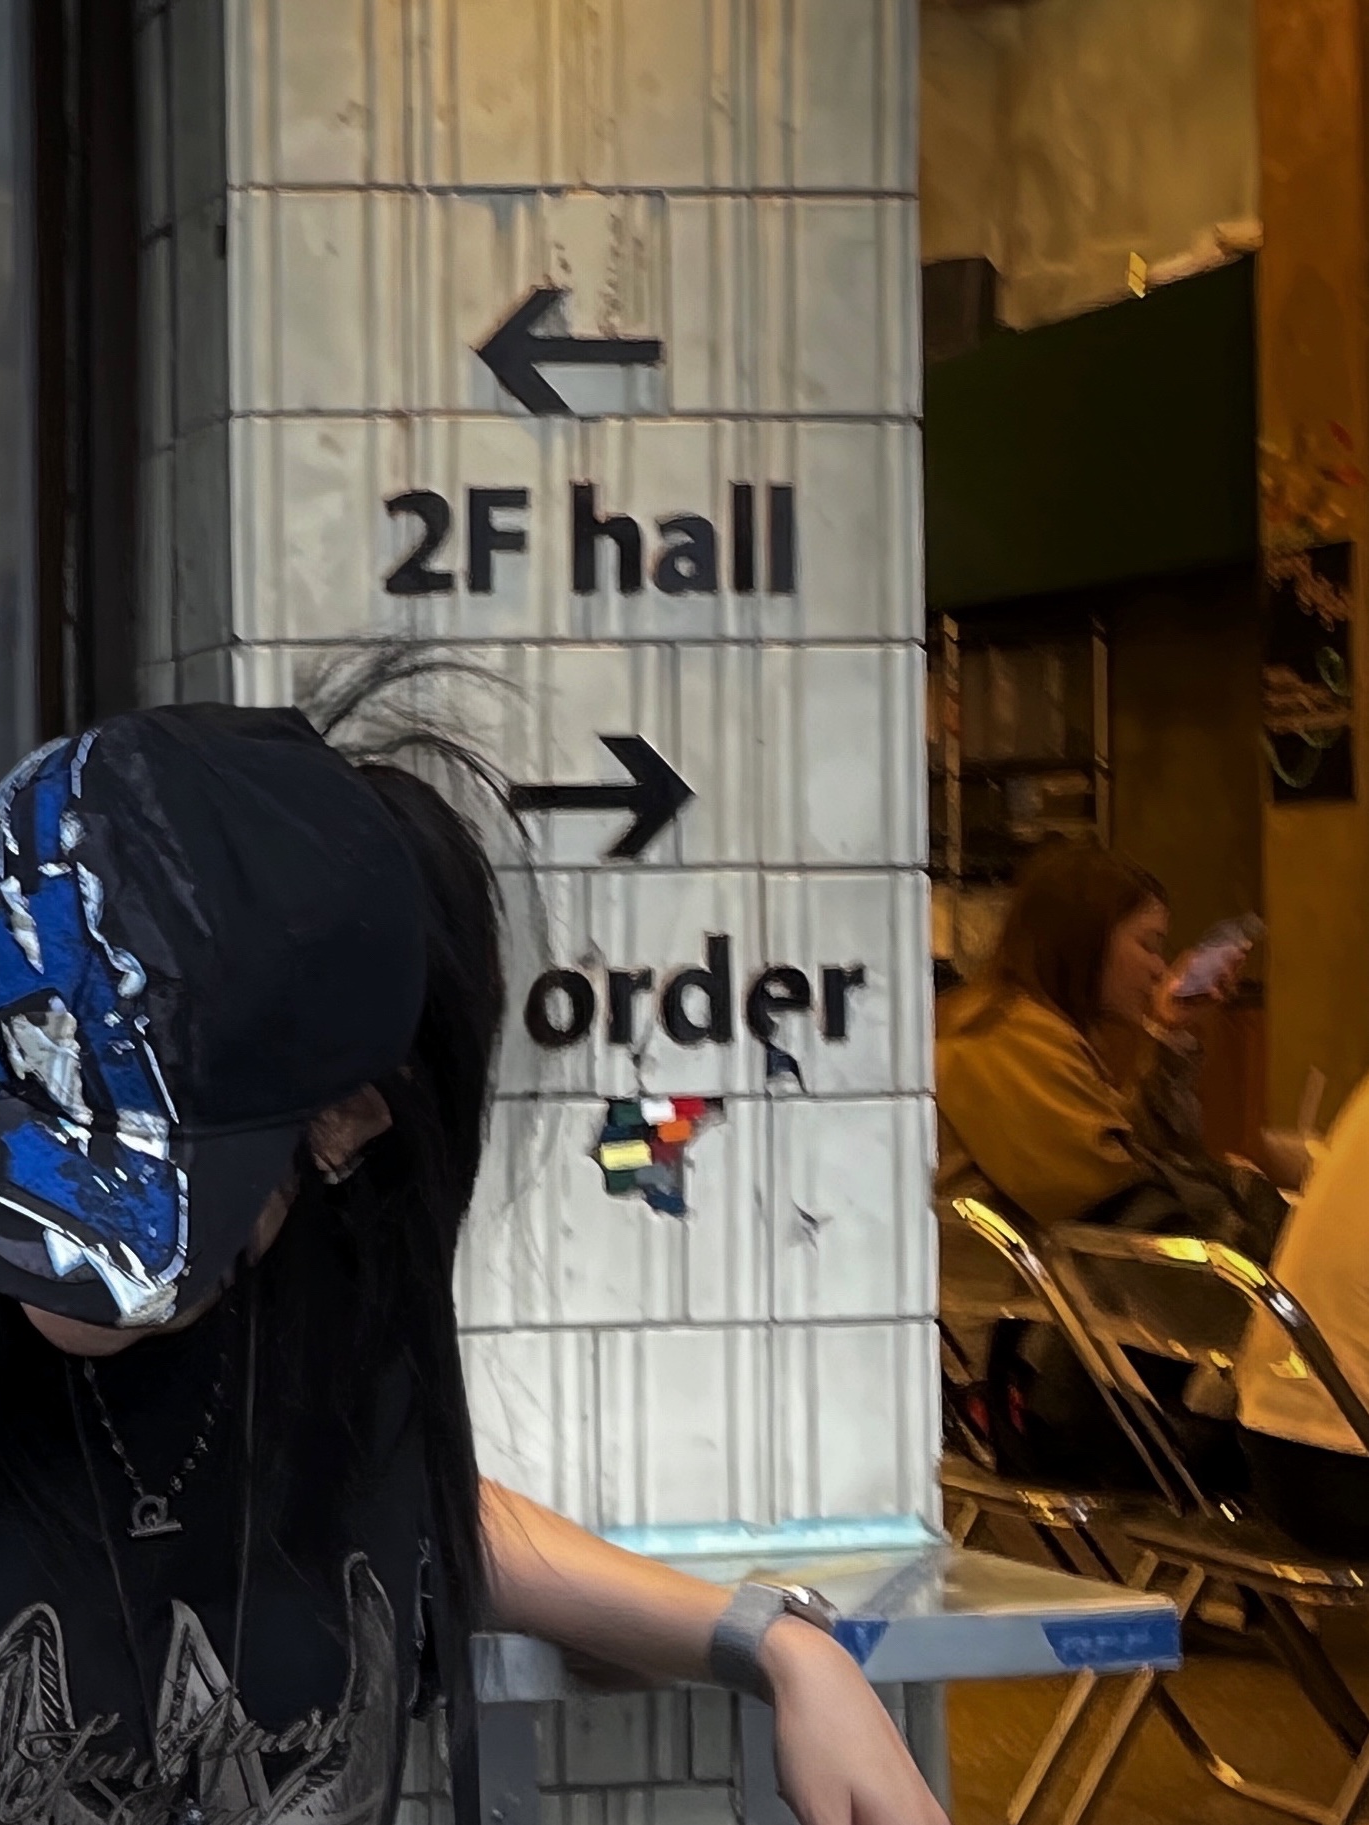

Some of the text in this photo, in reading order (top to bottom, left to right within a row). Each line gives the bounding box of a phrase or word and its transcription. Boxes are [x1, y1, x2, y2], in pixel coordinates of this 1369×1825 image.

[383, 480, 797, 598] 2F hall
[523, 932, 867, 1048] order
